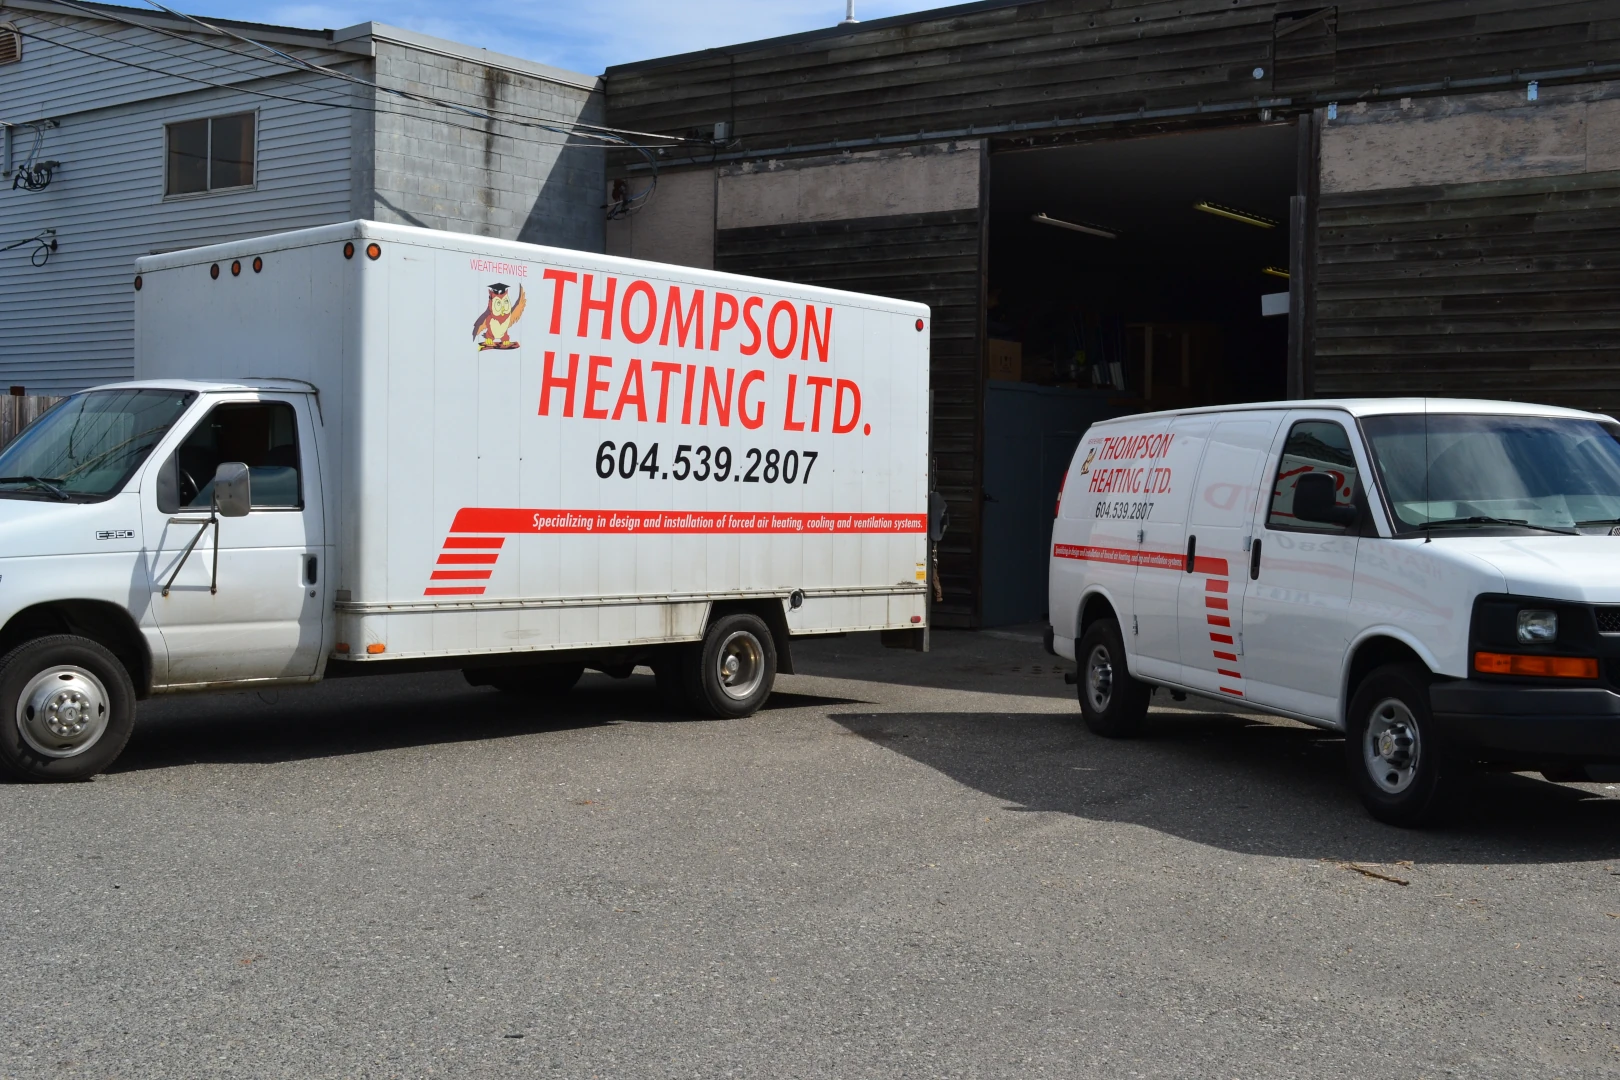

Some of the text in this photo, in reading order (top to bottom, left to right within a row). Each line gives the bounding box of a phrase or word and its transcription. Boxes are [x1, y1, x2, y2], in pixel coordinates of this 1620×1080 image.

[470, 259, 528, 278] WEATHERWISE
[543, 268, 833, 363] THOMPSON
[538, 351, 872, 437] HEATING LTD.
[1099, 433, 1175, 460] THOMPSON
[596, 440, 818, 485] 604.539.2807
[1088, 468, 1172, 494] HEATING LTD.
[532, 513, 923, 531] Specializing in design and installation of forced air heating, cooling and ventilation systems.
[1095, 501, 1154, 520] 604.539.2807
[96, 529, 135, 541] E350
